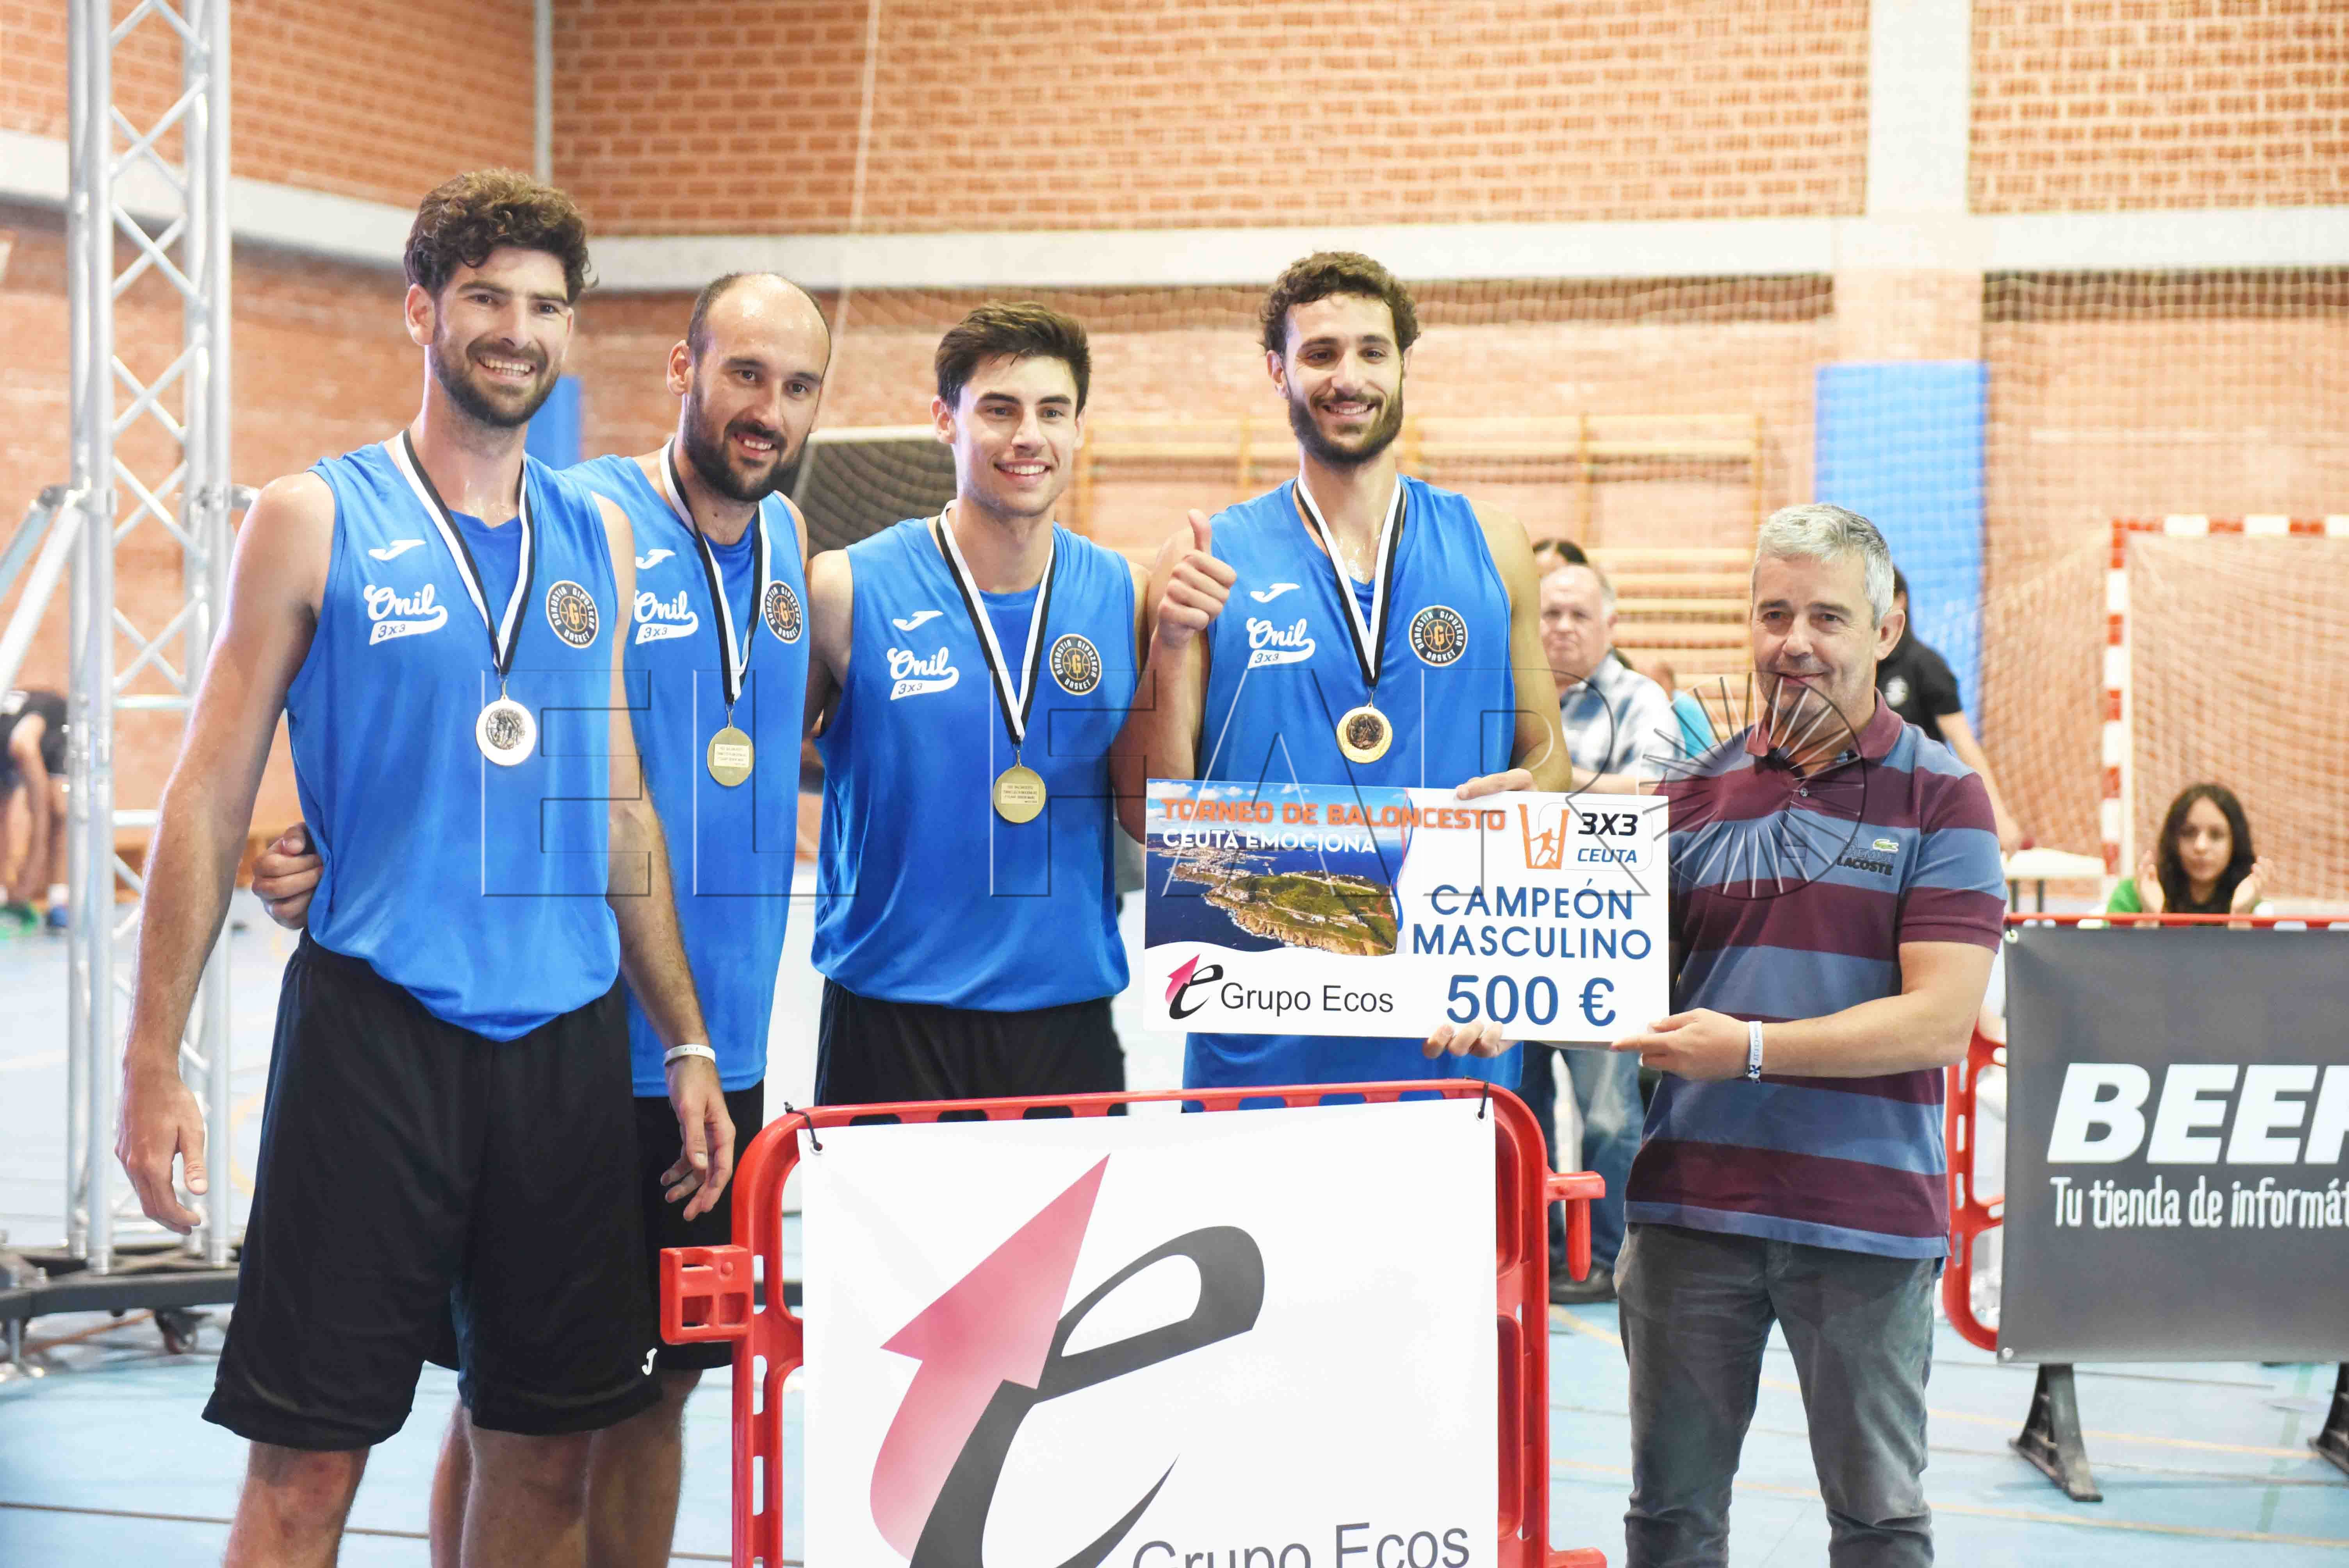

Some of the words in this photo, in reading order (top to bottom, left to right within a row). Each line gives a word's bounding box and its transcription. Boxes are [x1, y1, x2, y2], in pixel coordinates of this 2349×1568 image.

[364, 583, 447, 621] Onil
[634, 590, 698, 623] Onil
[378, 624, 406, 638] 3x3
[564, 629, 590, 643] BASKET
[643, 627, 668, 639] 3x3
[1246, 617, 1315, 650] Onil
[887, 647, 959, 680] Onil
[1255, 653, 1280, 663] 3x3
[1426, 649, 1456, 662] BASKET
[898, 683, 923, 695] 3x3
[1064, 677, 1091, 690] BASKET
[1161, 798, 1274, 822] TORNEO
[1282, 802, 1319, 825] DE
[1327, 804, 1506, 831] BALONCESTO
[1577, 812, 1638, 836] 3X3
[1162, 828, 1240, 849] CEUTA
[1246, 830, 1376, 854] EMOCIONA
[1577, 848, 1637, 863] CEUTA
[1836, 855, 1895, 876] LACOSTE
[1431, 878, 1633, 920] CAMPEÓN
[1413, 923, 1651, 960] MASCULINO
[1221, 982, 1312, 1017] Grupo
[1323, 984, 1394, 1013] Ecos
[1446, 974, 1559, 1026] 500
[1579, 976, 1616, 1027] €
[2050, 1176, 2083, 1228] Tu
[2089, 1175, 2182, 1229] tienda
[2189, 1175, 2223, 1228] de
[1336, 1522, 1470, 1568] Ecos
